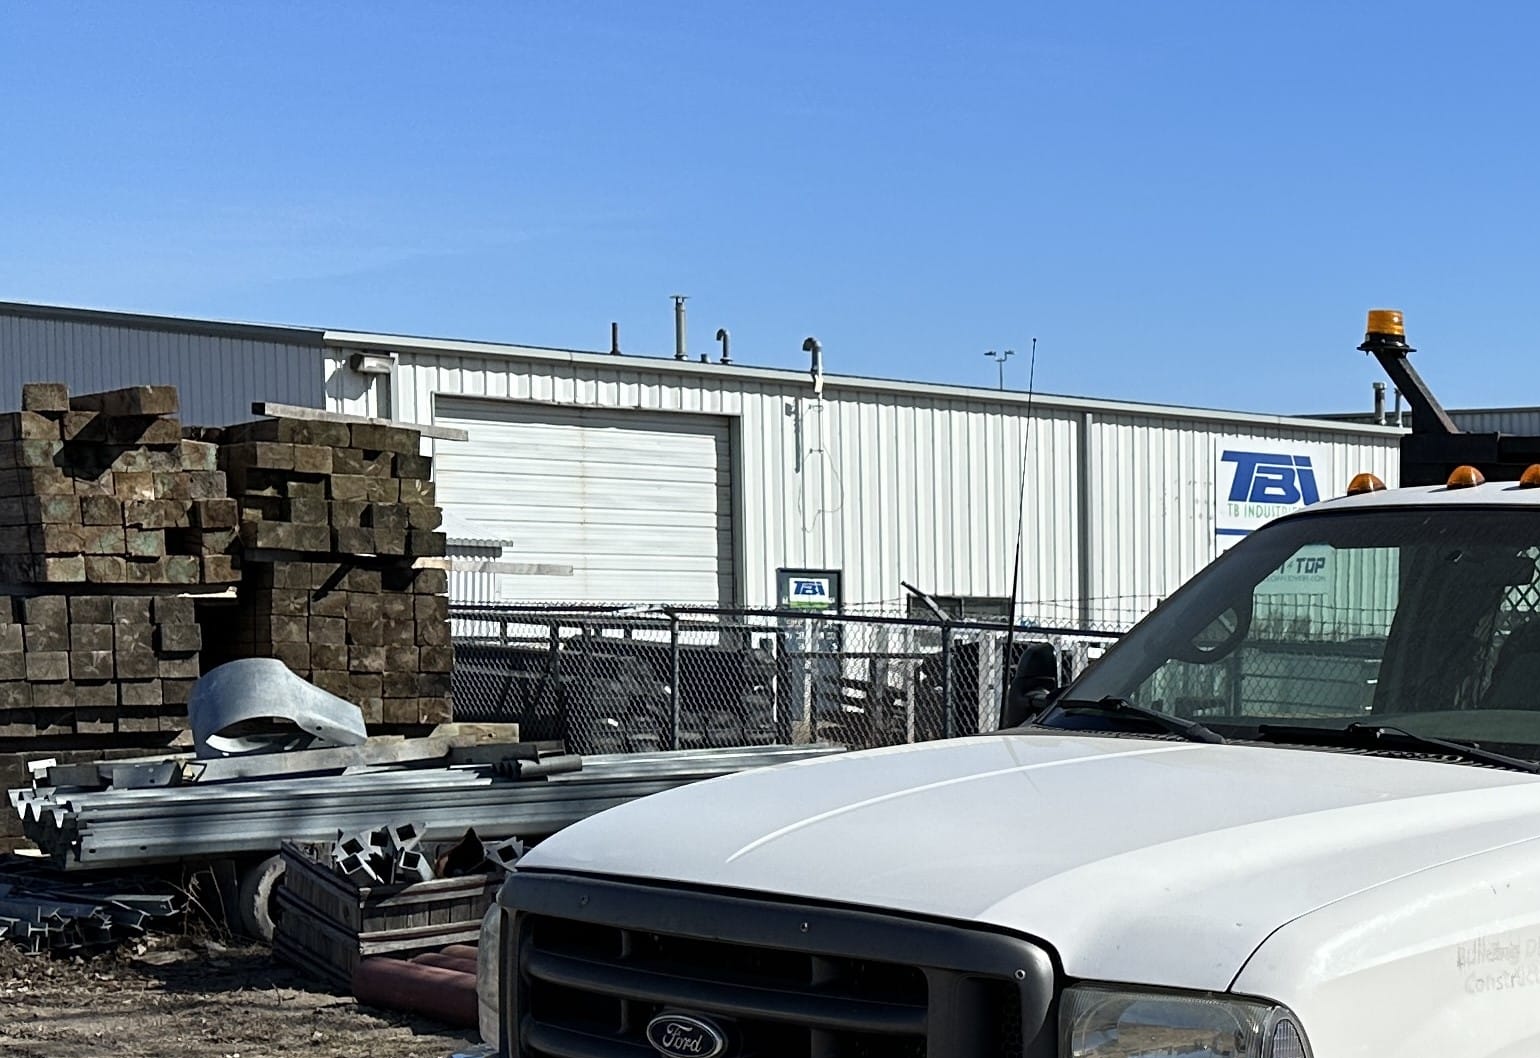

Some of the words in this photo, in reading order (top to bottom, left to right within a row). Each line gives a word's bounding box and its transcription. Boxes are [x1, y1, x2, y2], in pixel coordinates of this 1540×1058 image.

[1227, 503, 1239, 517] TB
[1296, 557, 1325, 574] TOP
[662, 1022, 703, 1053] Ford
